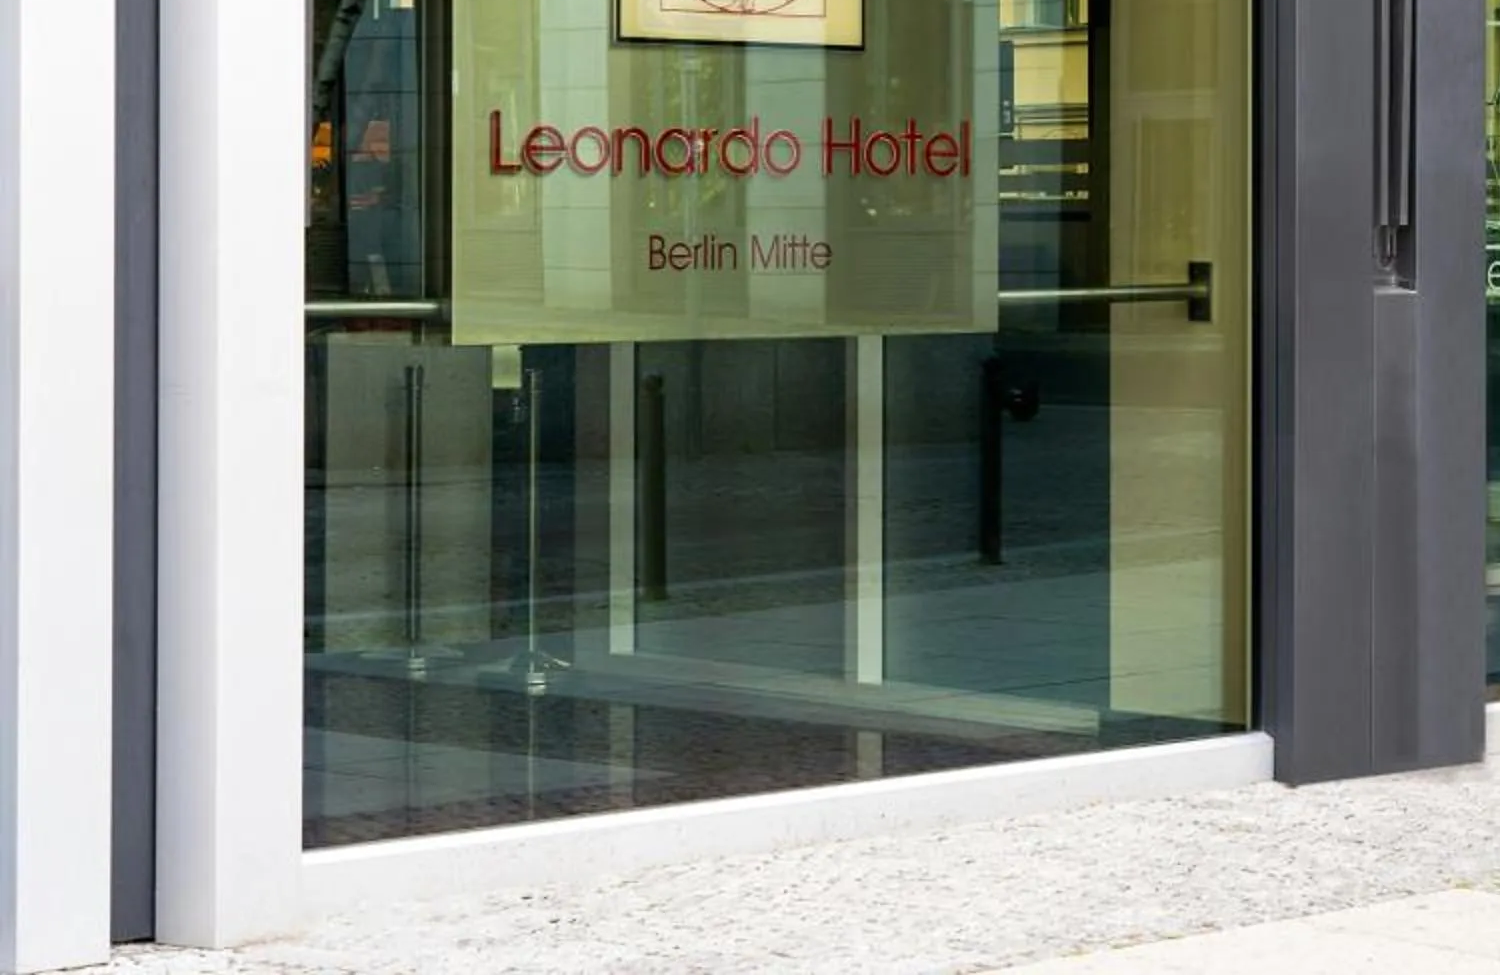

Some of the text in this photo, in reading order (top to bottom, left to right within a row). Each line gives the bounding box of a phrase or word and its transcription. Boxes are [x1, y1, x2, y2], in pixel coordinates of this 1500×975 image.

[488, 109, 971, 177] Leonardo Hotel
[648, 234, 833, 270] Berlin Mitte
